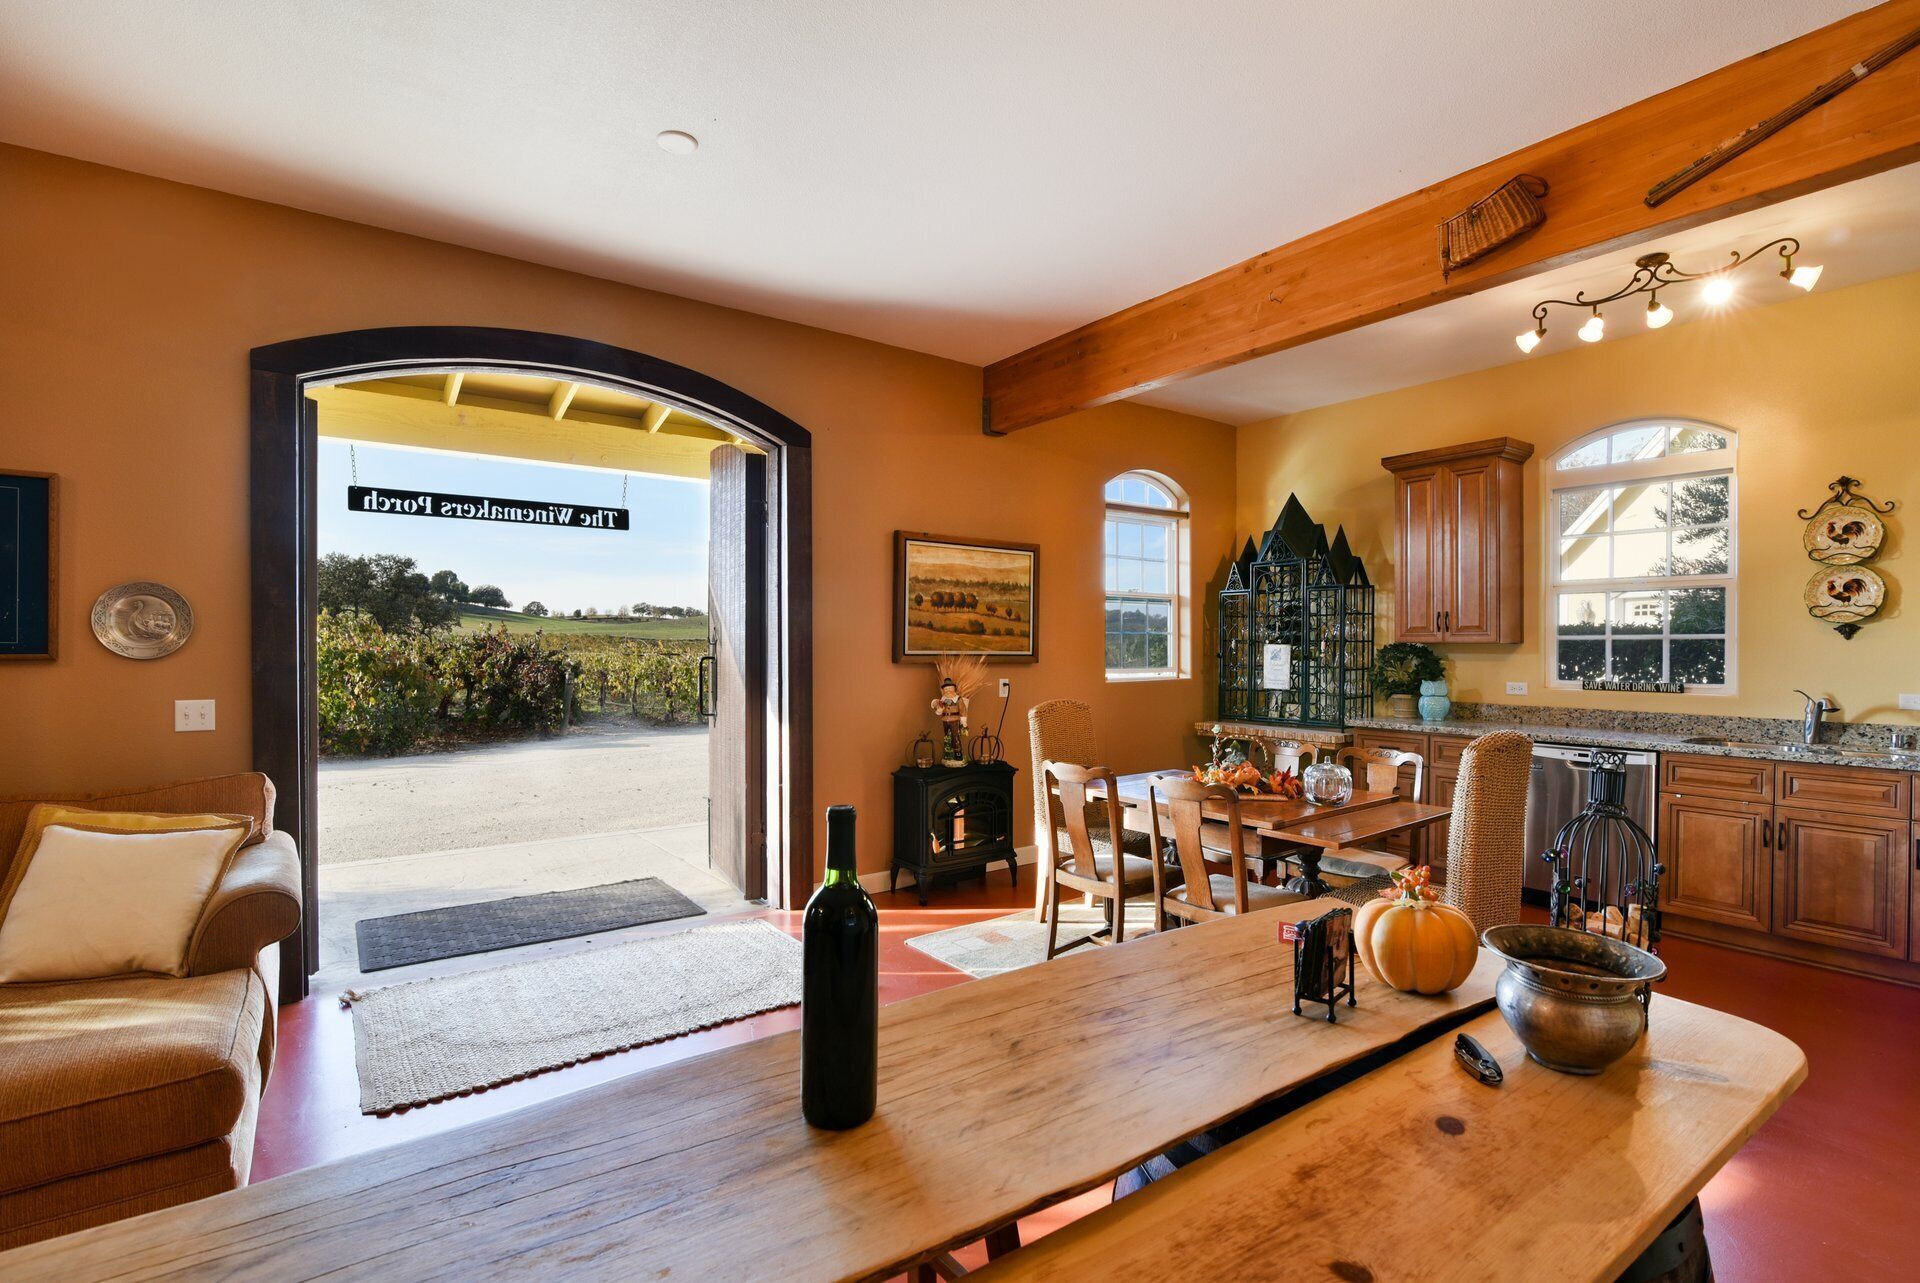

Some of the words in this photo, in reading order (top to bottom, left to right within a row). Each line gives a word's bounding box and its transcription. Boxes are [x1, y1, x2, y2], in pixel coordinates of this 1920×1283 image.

[1584, 681, 1603, 690] SAVE
[1604, 682, 1631, 690] WATER
[1632, 682, 1657, 692] DRINK
[1658, 683, 1681, 693] WINE
